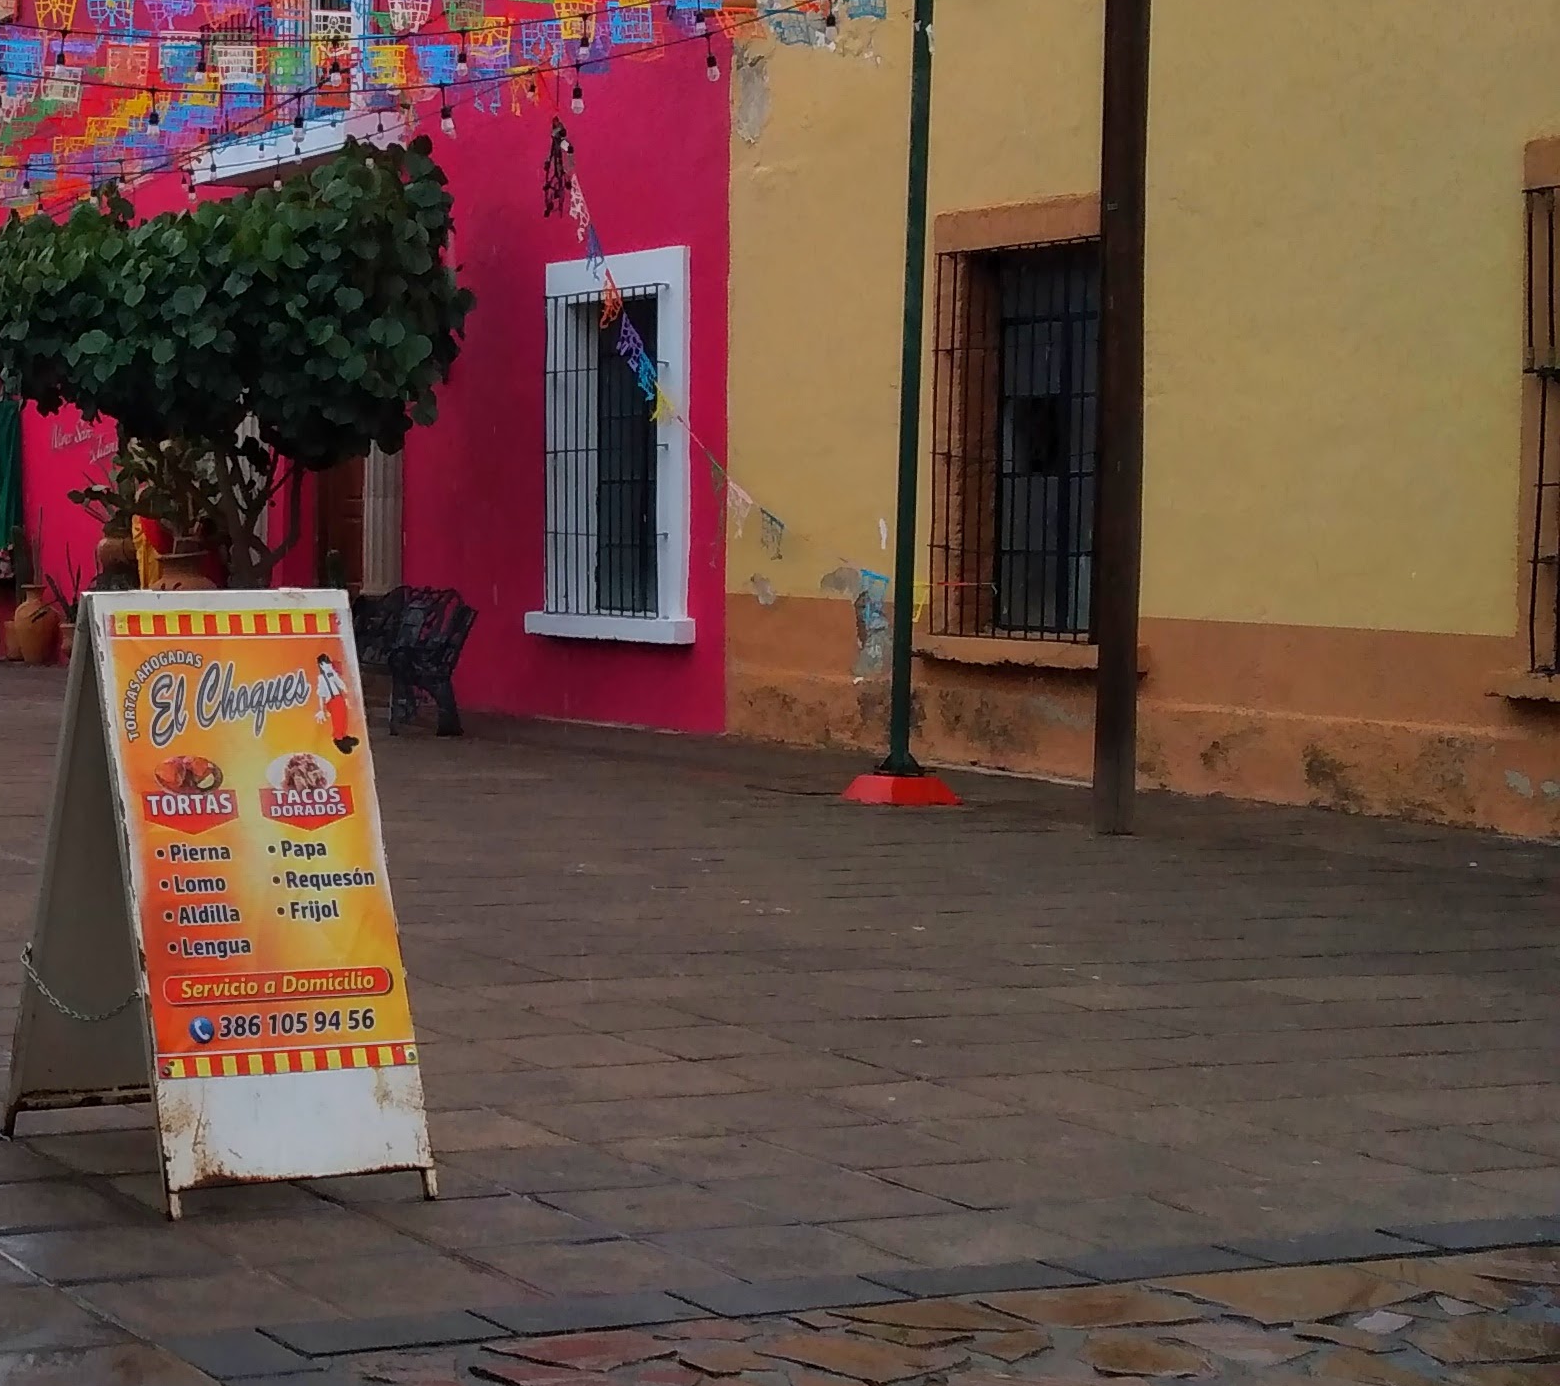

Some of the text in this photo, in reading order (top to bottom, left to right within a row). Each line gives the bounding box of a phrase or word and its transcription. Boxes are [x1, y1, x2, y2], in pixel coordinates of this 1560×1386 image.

[128, 650, 203, 742] TORTAS AHOGADAS
[151, 661, 310, 747] El Choques
[147, 793, 234, 816] TORTAS
[272, 787, 341, 804] TACOS
[270, 803, 347, 818] DORADOS
[170, 844, 231, 862] Pierna
[281, 840, 327, 860] Papa
[174, 875, 226, 894] Lomo
[285, 868, 376, 890] Requesón
[178, 905, 241, 927] Aldilla
[290, 899, 340, 922] Frijol
[181, 937, 252, 960] Lengua
[181, 974, 375, 999] Servicio a Domicilio
[218, 1009, 375, 1039] 386 105 94 56
